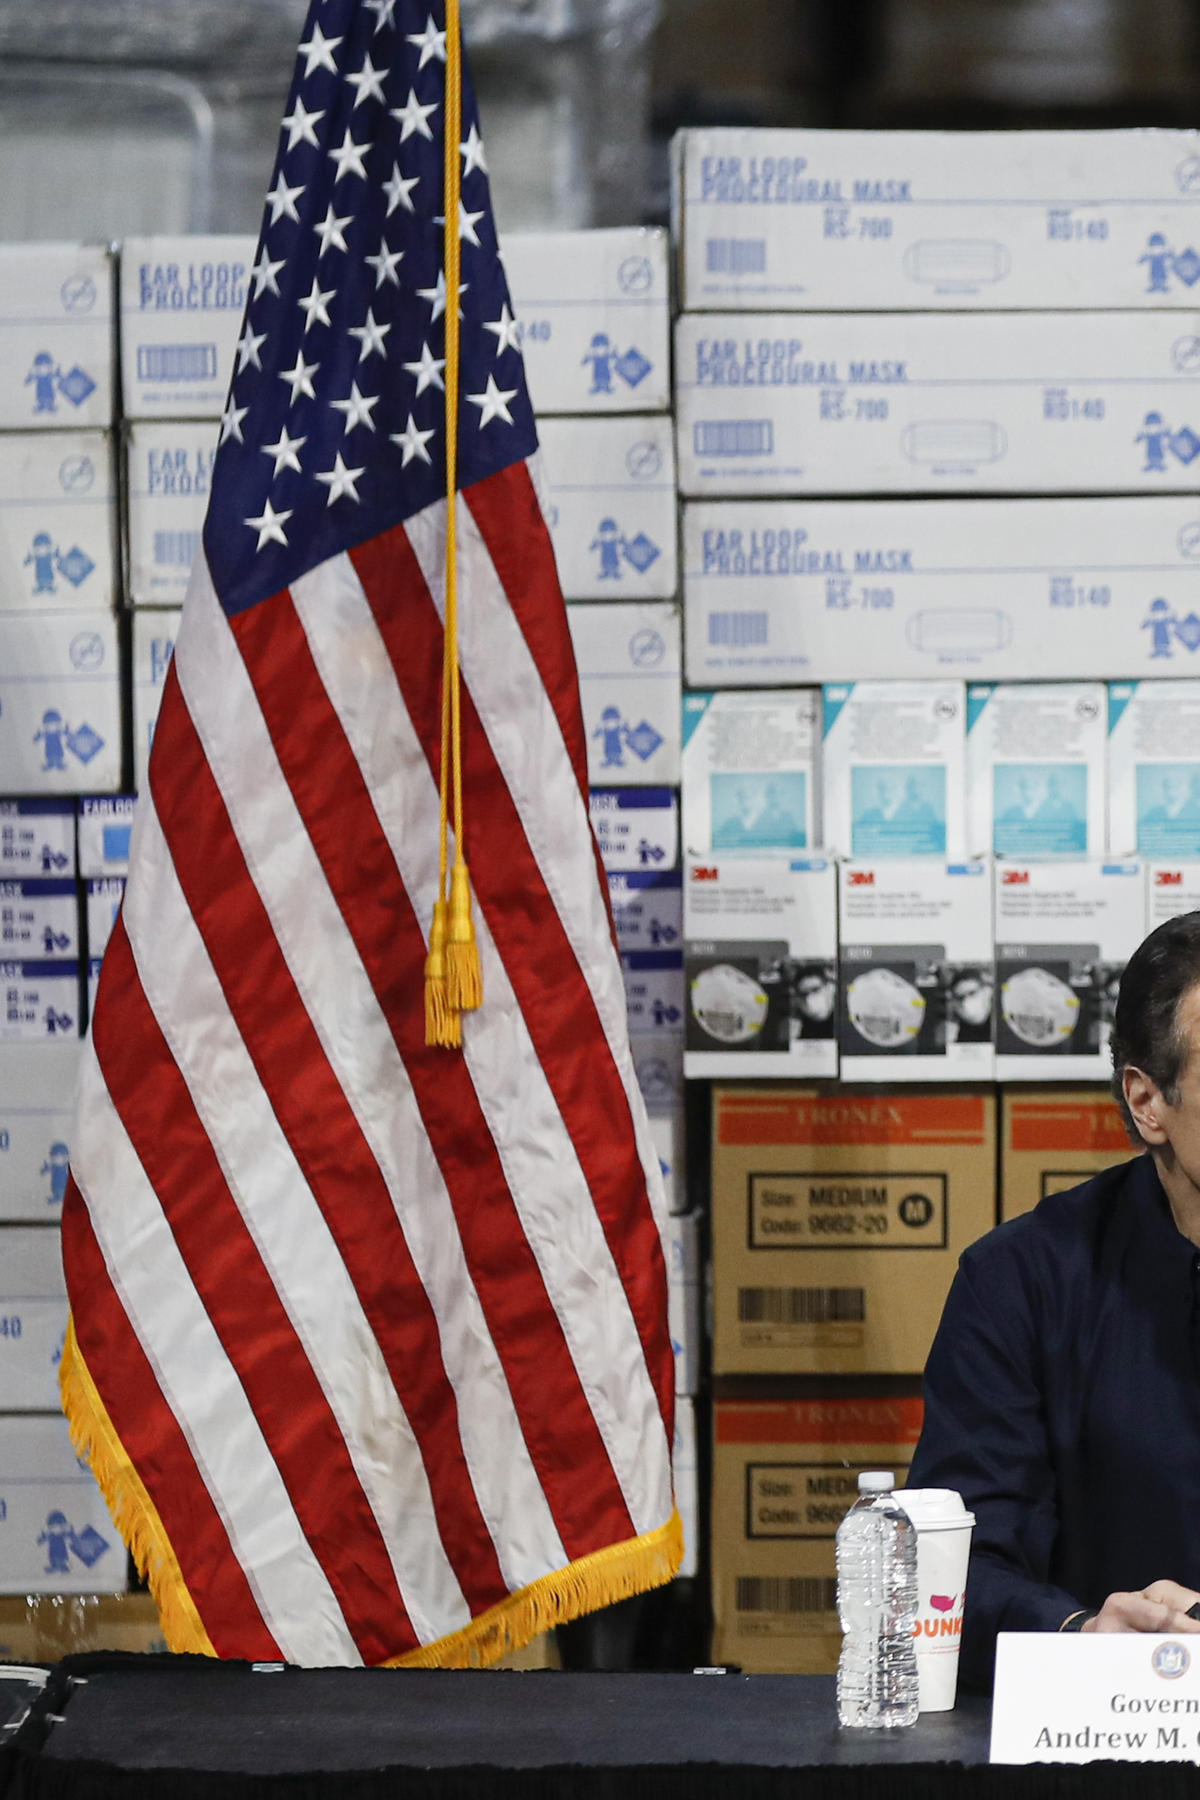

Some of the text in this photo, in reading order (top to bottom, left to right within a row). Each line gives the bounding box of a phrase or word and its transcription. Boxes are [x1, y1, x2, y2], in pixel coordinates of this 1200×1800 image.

[702, 157, 807, 180] EAR LOOP
[702, 178, 912, 205] PROCEDURAL MASK
[140, 263, 246, 286] EAR LOOP
[696, 340, 802, 363] EAR LOOP
[697, 361, 907, 386] PROCEDURAL MASK
[149, 450, 187, 471] EAR
[703, 529, 808, 551] EAR LOOP
[703, 549, 913, 576] PROCEDURAL MASK
[691, 866, 718, 882] 3M
[847, 871, 875, 886] 3M
[1002, 871, 1029, 885] 3M
[1155, 872, 1183, 886] 3M
[810, 1187, 888, 1207] MEDIUM
[1034, 1726, 1148, 1749] Andrew
[1156, 1728, 1187, 1749] M.
